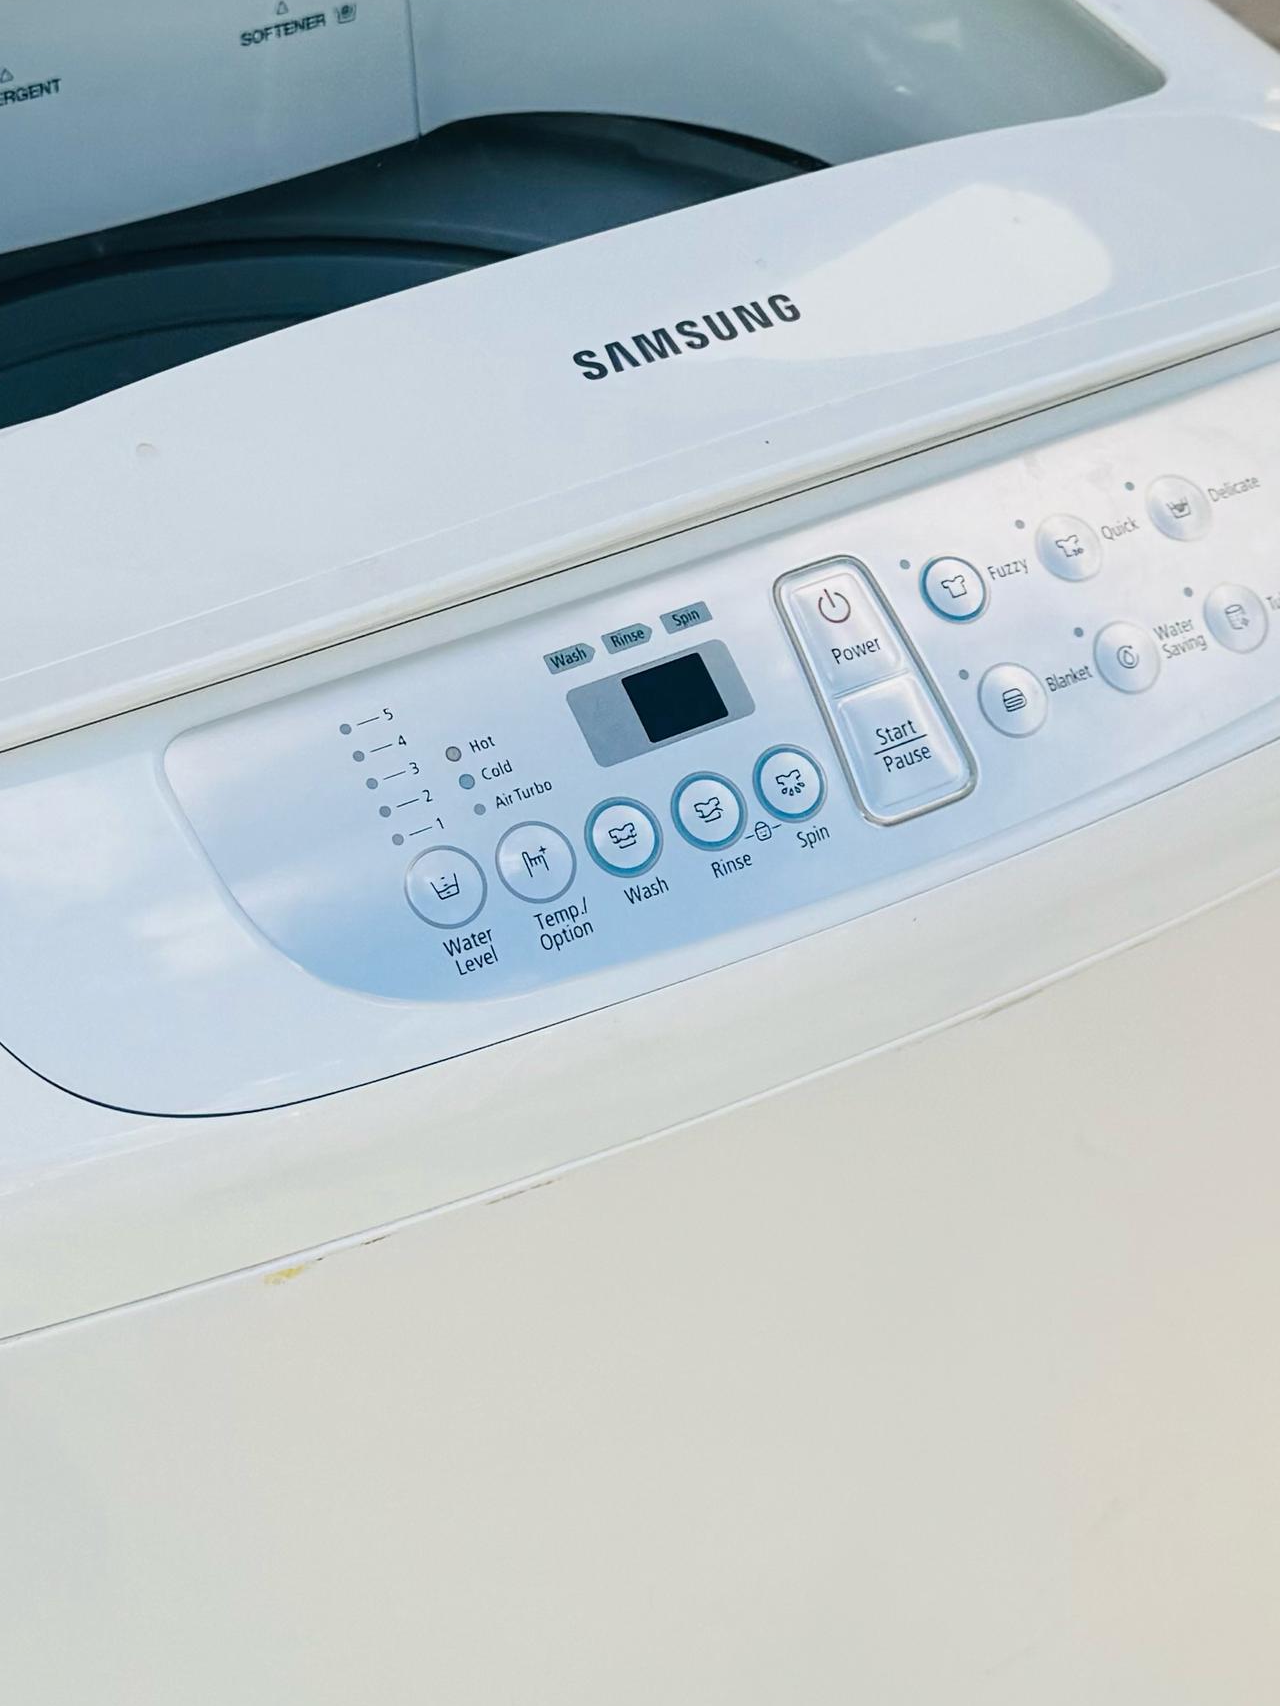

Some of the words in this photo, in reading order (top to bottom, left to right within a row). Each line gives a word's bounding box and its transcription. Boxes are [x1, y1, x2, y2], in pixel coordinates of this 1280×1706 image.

[240, 13, 326, 47] SOFTENER
[572, 293, 801, 381] SAMSUNG
[1207, 475, 1261, 503] Delicate
[1100, 516, 1140, 541] Quick
[987, 557, 1029, 581] Fuzzy
[671, 608, 701, 628] Spin
[1152, 617, 1195, 642] Water
[609, 627, 646, 648] Rinse
[1161, 633, 1209, 660] Saving
[550, 647, 587, 669] Wash
[831, 638, 881, 665] Power
[1045, 664, 1094, 693] Blanket
[382, 707, 394, 721] 5
[397, 734, 408, 747] 4
[468, 735, 496, 754] Hot
[875, 719, 917, 746] Start
[408, 761, 420, 775] 3
[481, 759, 513, 780] Cold
[882, 745, 932, 773] Pause
[422, 789, 433, 803] 2
[495, 787, 513, 809] Air
[513, 779, 553, 802] Turbo
[435, 817, 445, 830] 1
[796, 825, 830, 849] Spin
[710, 852, 753, 879] Rinse
[624, 876, 670, 906] Wash
[533, 896, 589, 932] Temp./
[442, 927, 494, 958] Water
[539, 920, 595, 952] Option
[455, 945, 499, 977] Level
